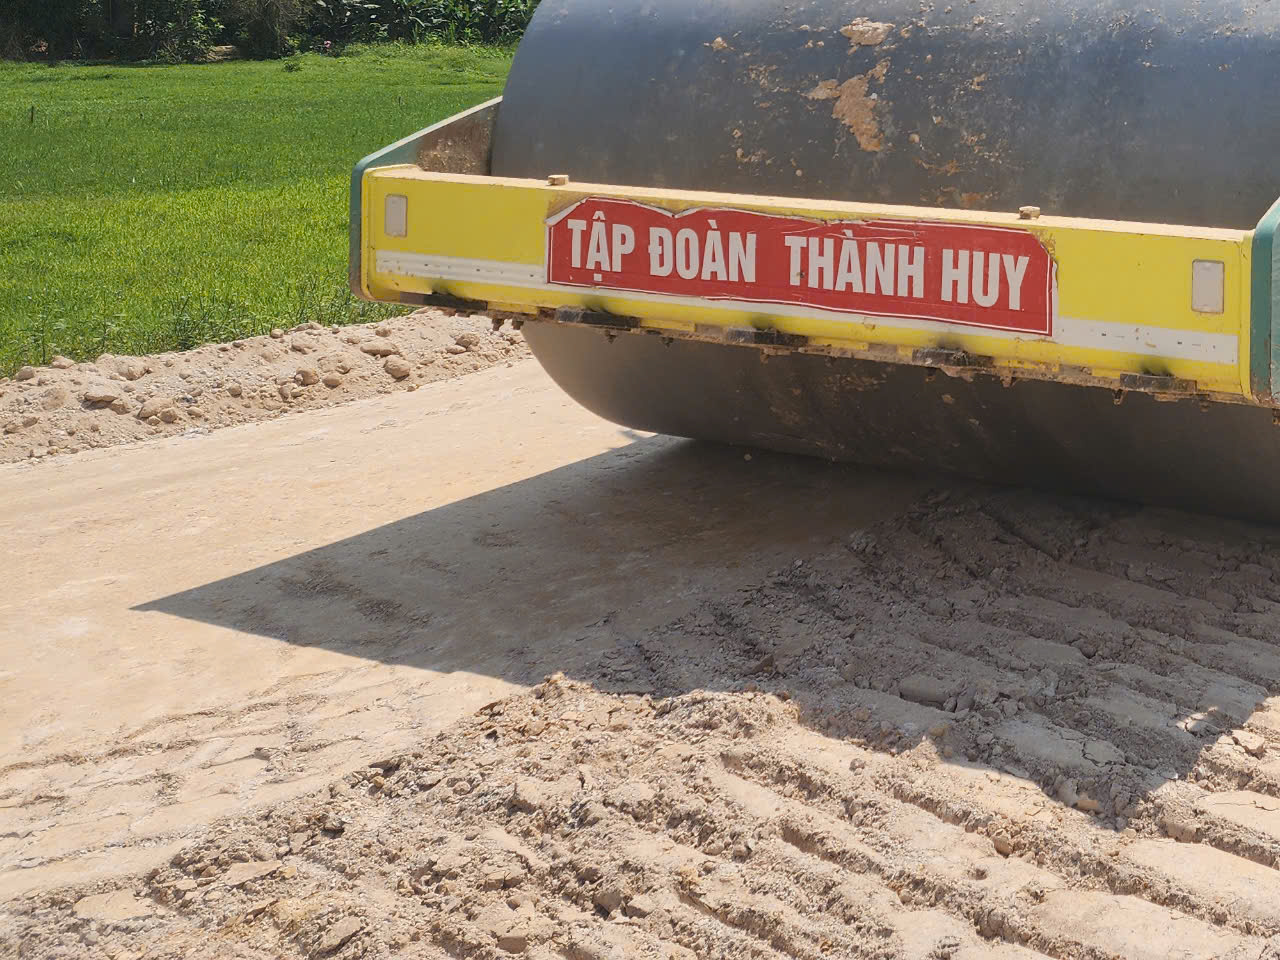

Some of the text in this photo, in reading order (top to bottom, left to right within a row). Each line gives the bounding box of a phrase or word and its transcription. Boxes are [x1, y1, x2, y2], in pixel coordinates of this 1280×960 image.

[567, 211, 1030, 310] TẬP ĐOÀN THÀNH HUY
